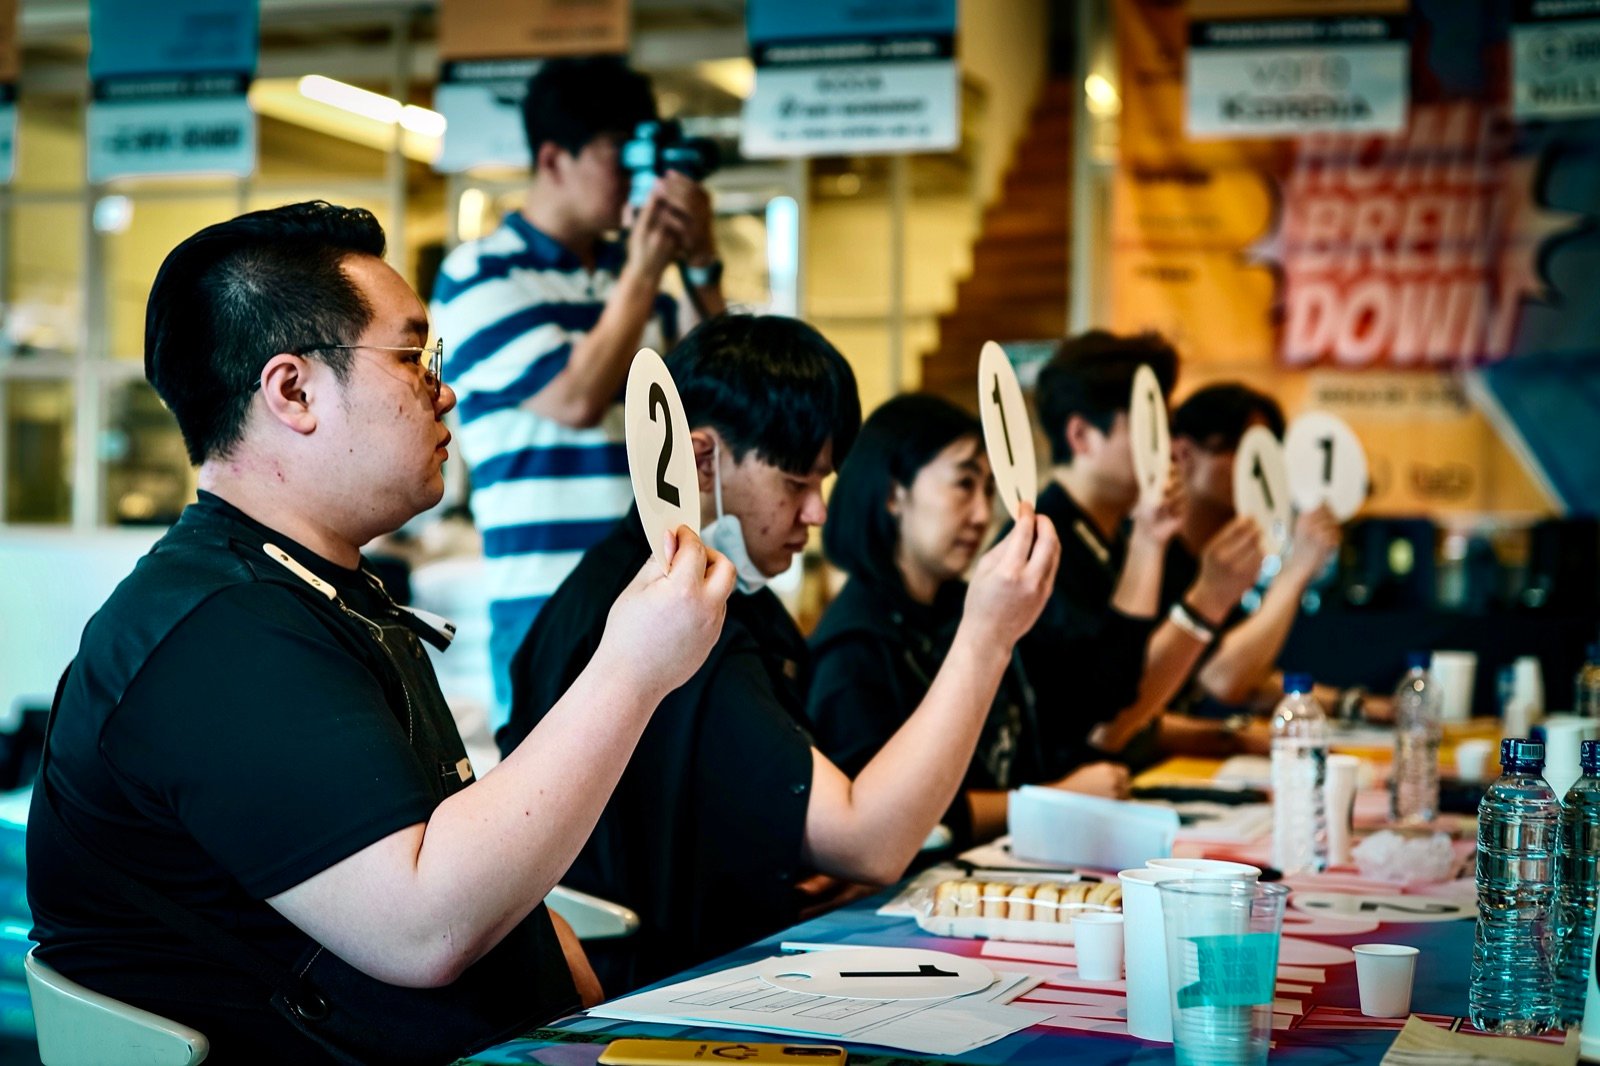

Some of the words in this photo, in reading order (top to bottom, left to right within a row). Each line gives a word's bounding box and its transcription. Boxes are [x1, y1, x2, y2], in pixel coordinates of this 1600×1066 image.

[1284, 281, 1518, 367] DOWN
[648, 382, 681, 509] 2
[991, 373, 1015, 466] 1
[1147, 390, 1160, 453] 1
[1251, 451, 1275, 511] 1
[1315, 435, 1335, 486] 1
[840, 964, 960, 978] 1
